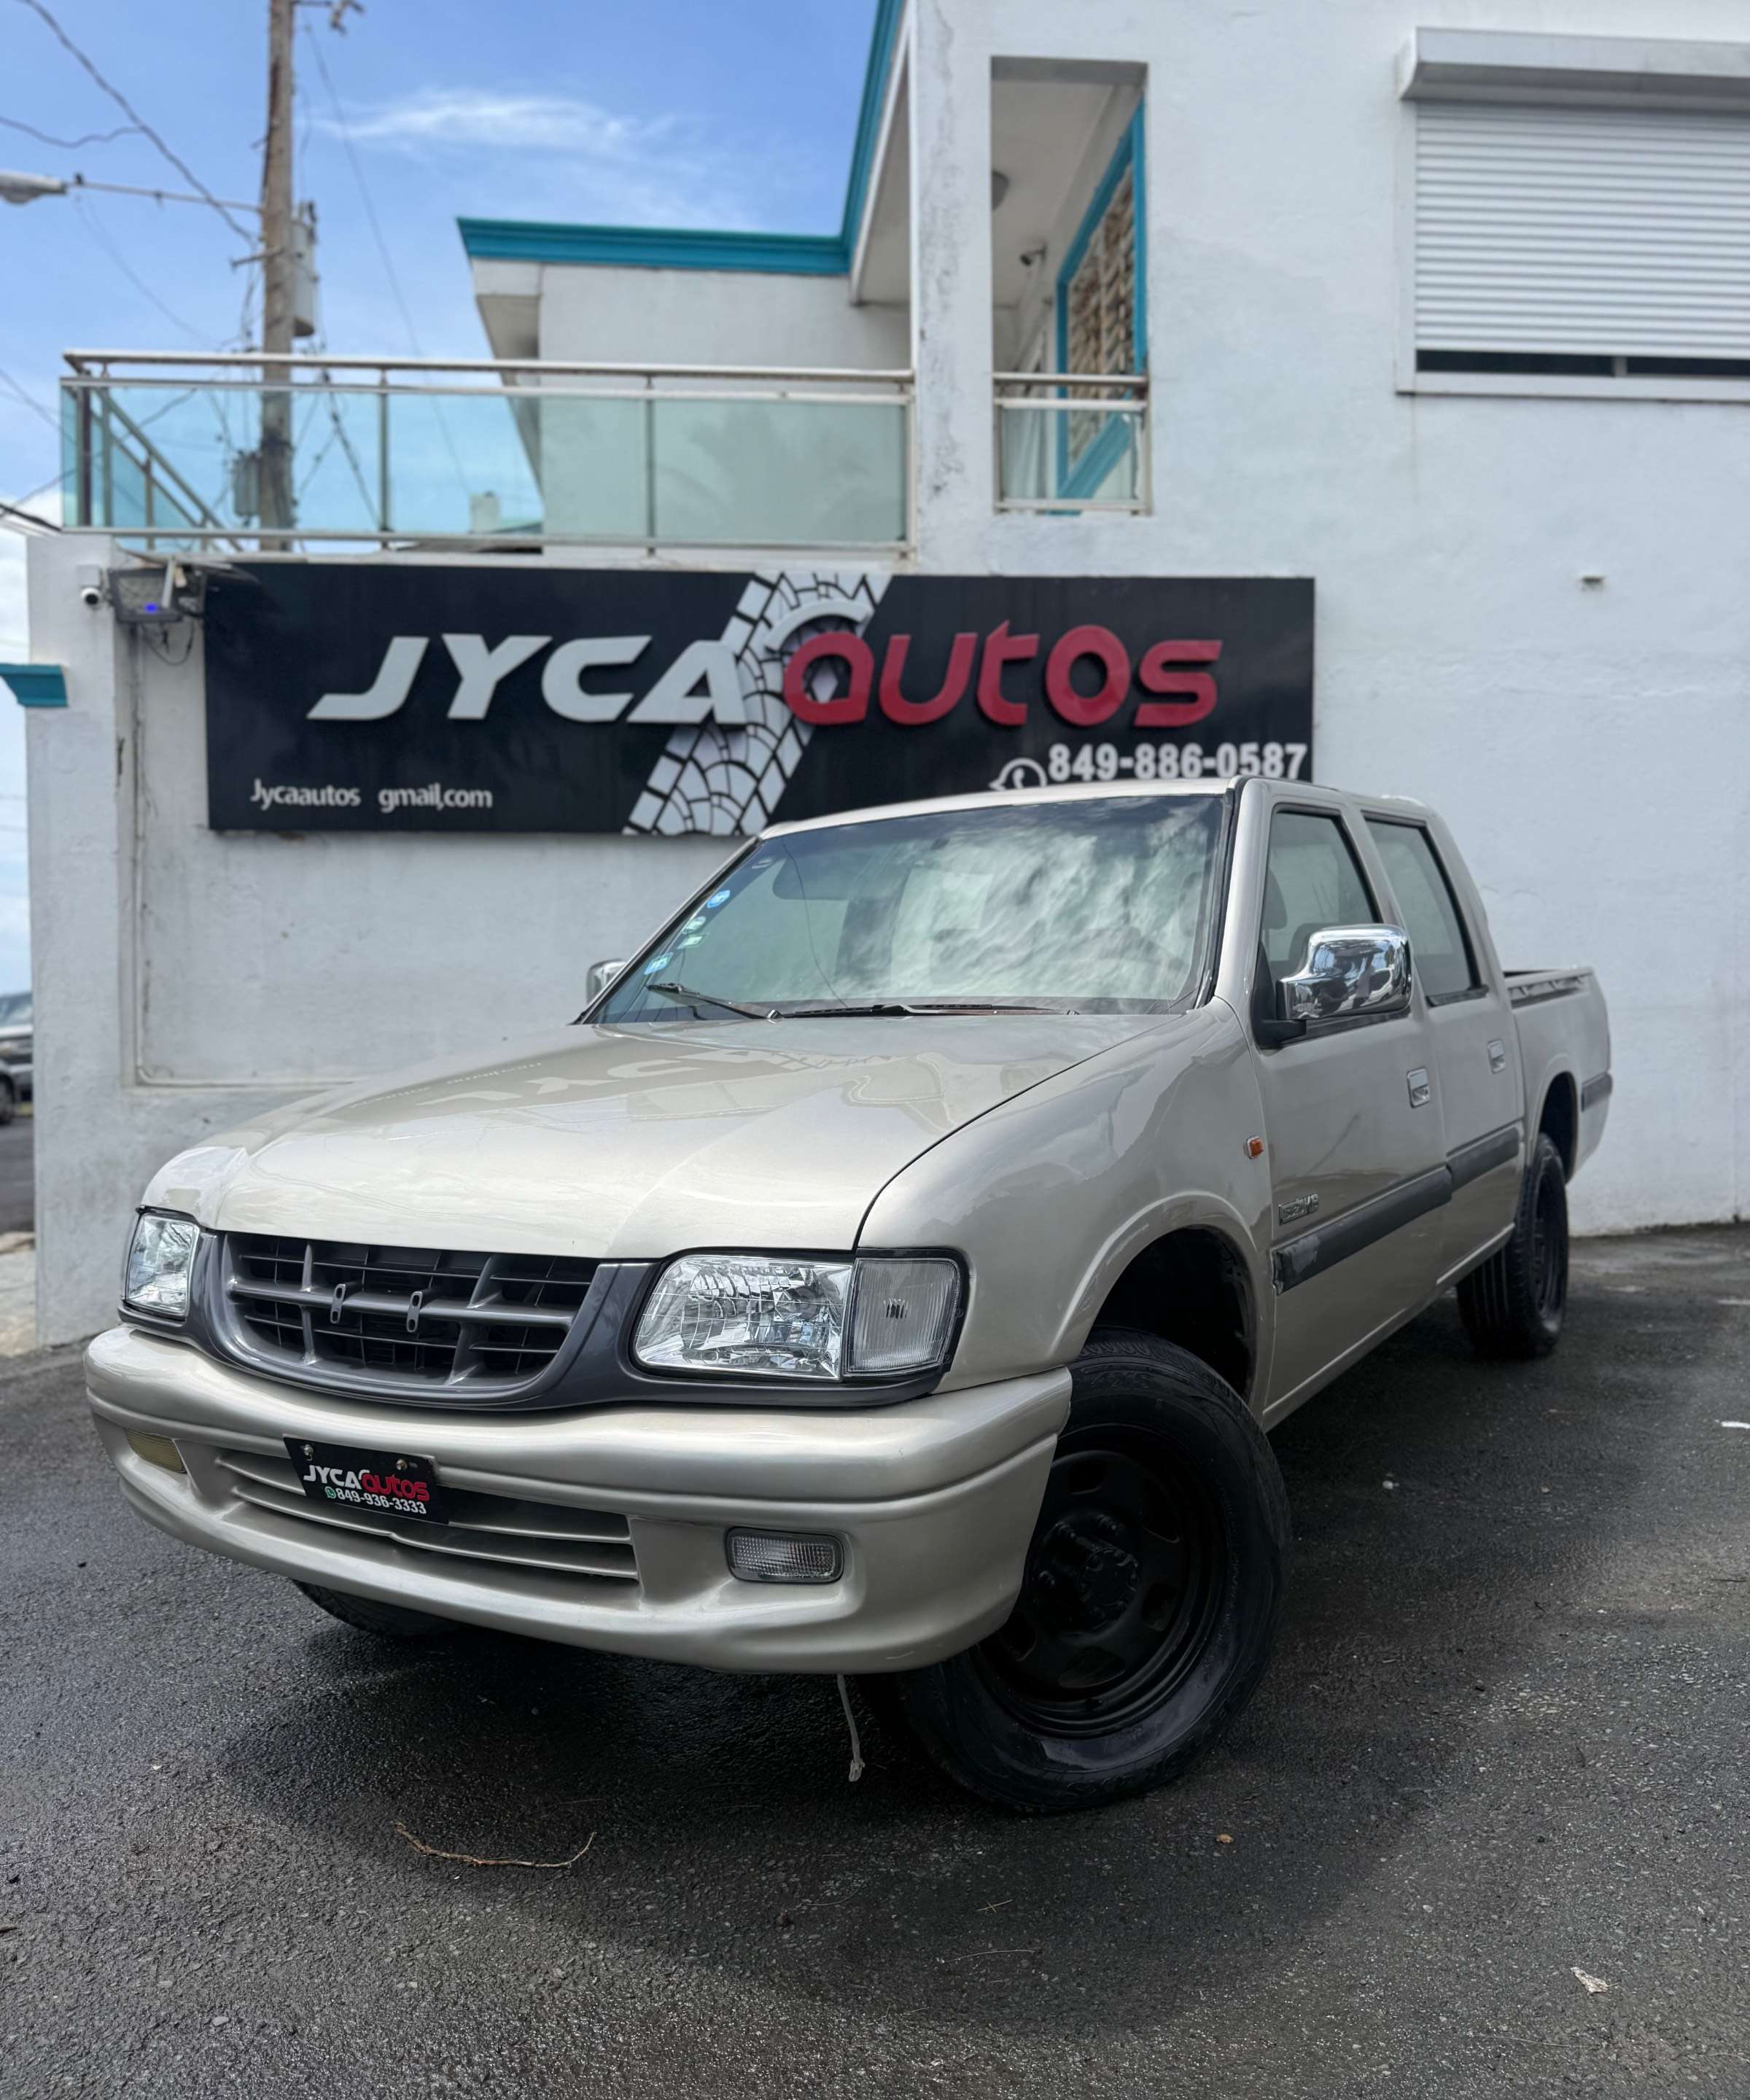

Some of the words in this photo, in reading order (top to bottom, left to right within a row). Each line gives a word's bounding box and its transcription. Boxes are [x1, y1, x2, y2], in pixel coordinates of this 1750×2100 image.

[306, 633, 750, 723] JYCA
[1048, 742, 1307, 781] 849-886-0587
[250, 778, 361, 811] Jycaautos
[335, 1488, 427, 1514] 849-936-3333
